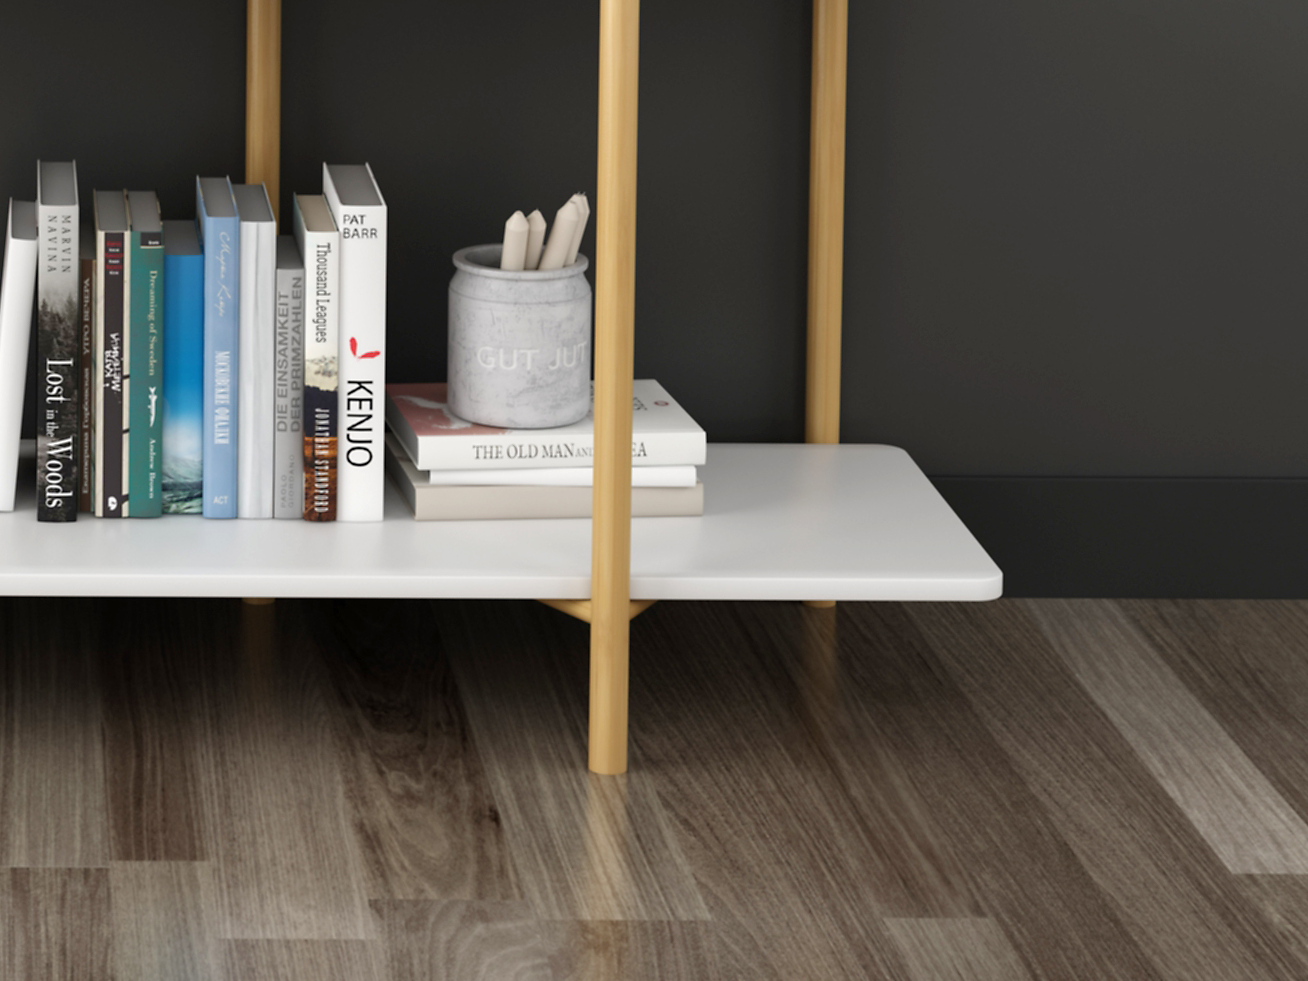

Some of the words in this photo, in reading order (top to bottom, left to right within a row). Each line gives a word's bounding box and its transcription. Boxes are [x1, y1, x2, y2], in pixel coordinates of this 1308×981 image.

[342, 215, 366, 225] PAT
[342, 228, 378, 239] BARR
[47, 215, 57, 272] NAVINA
[61, 215, 71, 272] MARVIN
[316, 242, 331, 296] Thousand
[147, 270, 158, 321] Dreaming
[149, 322, 157, 334] of
[291, 277, 302, 391] PRIMZAHLEN
[312, 299, 330, 343] Leagues
[149, 335, 158, 376] Sweden
[277, 291, 289, 398] EINSAMKEIT
[476, 346, 539, 369] GUT
[46, 358, 73, 403] Lost
[46, 421, 60, 437] the
[277, 403, 288, 432] DIE
[291, 396, 301, 433] DER
[314, 408, 330, 456] JONATHAN
[346, 380, 373, 467] KENJO
[45, 436, 73, 508] Woods
[473, 445, 503, 460] THE
[506, 443, 539, 459] OLD
[542, 443, 575, 459] MAN
